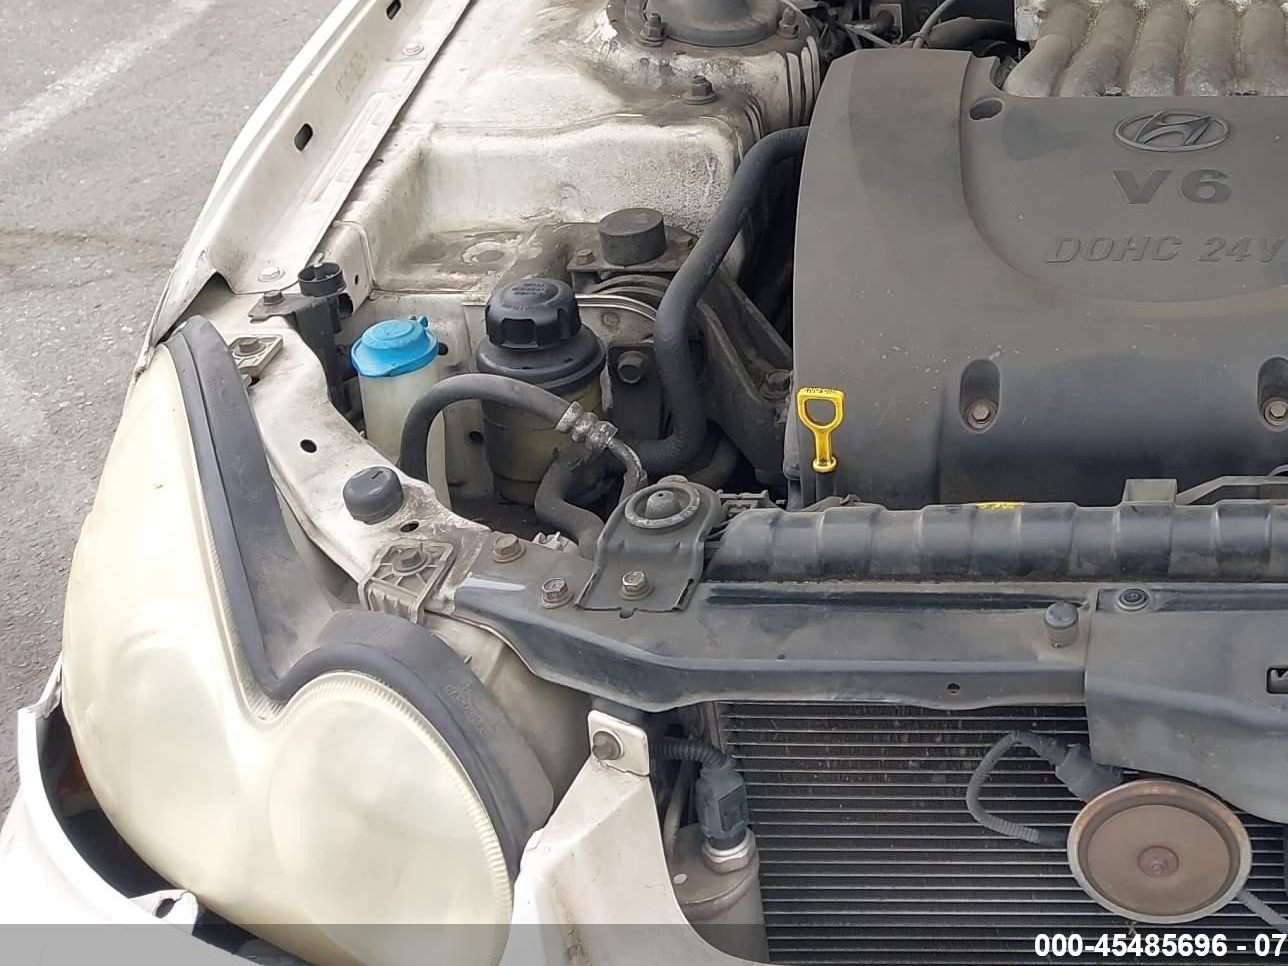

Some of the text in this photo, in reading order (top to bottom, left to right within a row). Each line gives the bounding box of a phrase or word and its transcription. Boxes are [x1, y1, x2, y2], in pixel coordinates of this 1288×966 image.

[1112, 169, 1232, 205] V6
[1045, 235, 1286, 264] DOHC 24V
